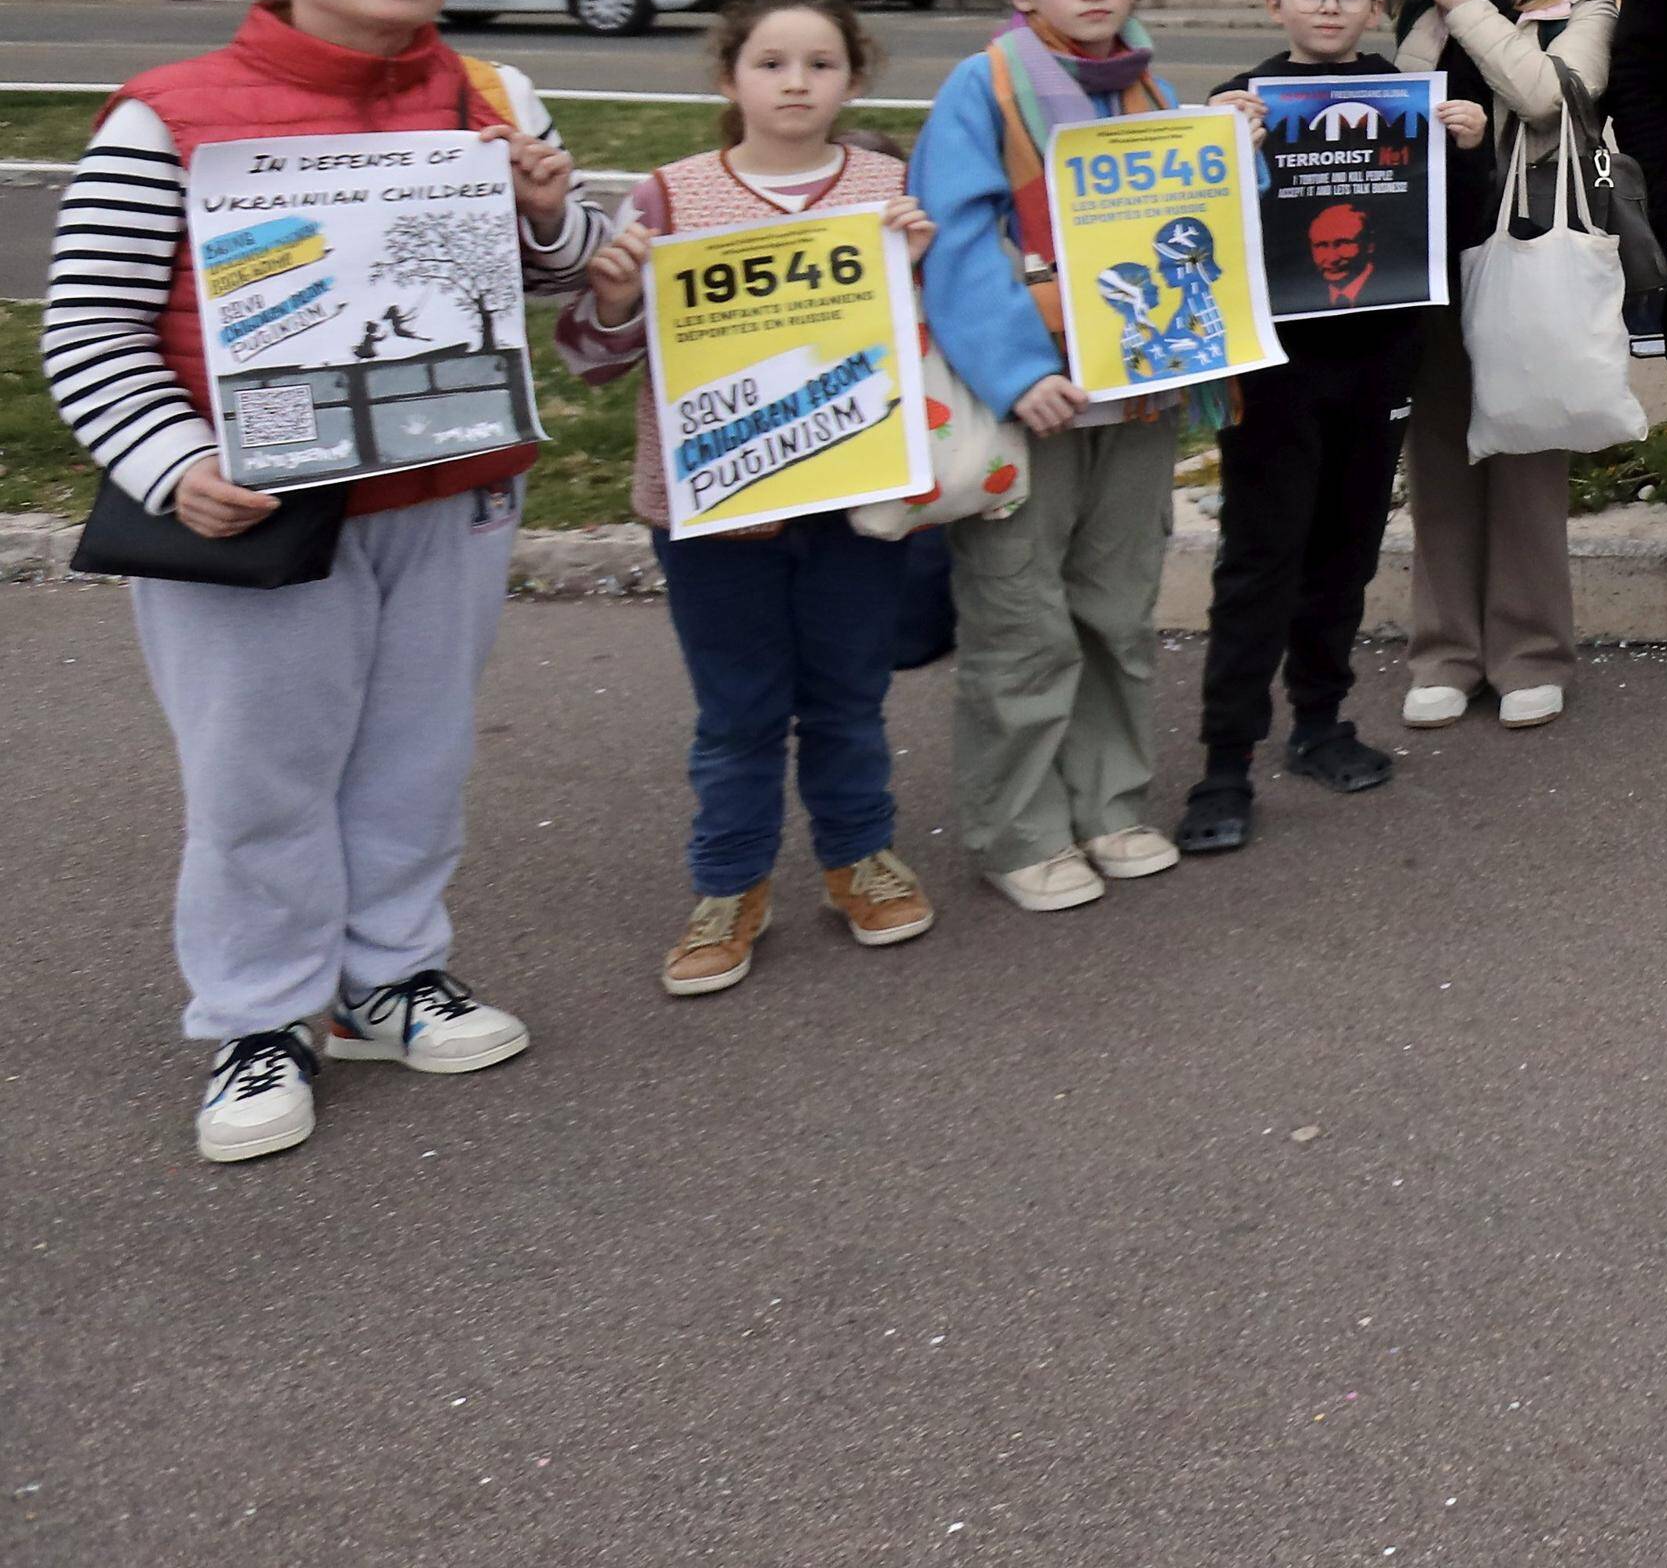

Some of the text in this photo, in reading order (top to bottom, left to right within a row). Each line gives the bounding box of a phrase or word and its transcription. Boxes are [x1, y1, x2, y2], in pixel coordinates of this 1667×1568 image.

[247, 148, 464, 175] IN DEFENSE OF
[1065, 144, 1227, 197] 19546
[1275, 150, 1373, 168] TERRORIST
[202, 182, 509, 214] UKRAINIAN CHILDREN
[674, 244, 865, 309] 19546
